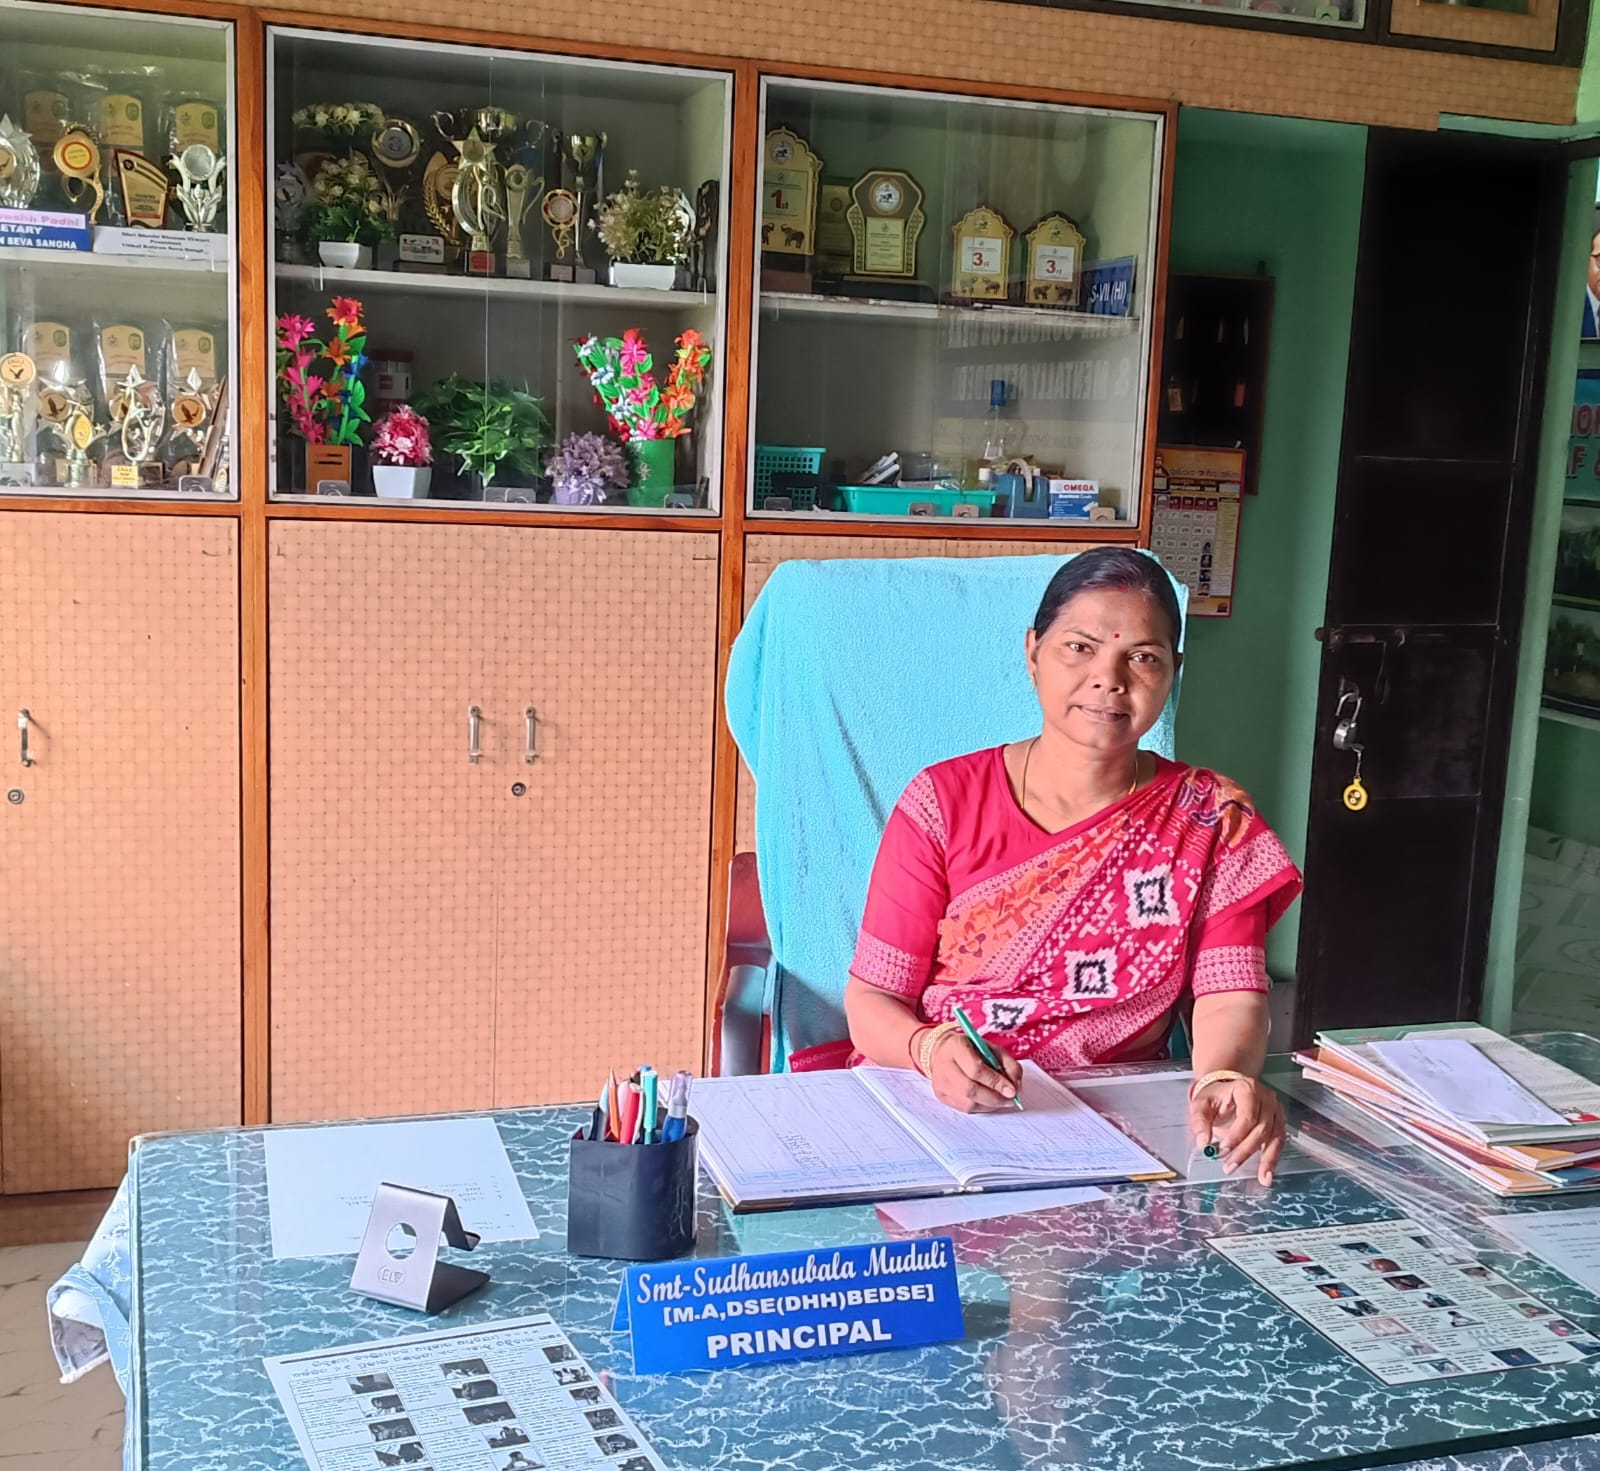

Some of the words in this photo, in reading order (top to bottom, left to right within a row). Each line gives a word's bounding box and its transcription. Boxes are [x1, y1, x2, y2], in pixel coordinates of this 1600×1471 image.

[636, 1251, 856, 1304] Smt-Sudhansubala
[863, 1242, 948, 1278] Muduli
[706, 1318, 892, 1359] PRINCIPAL
